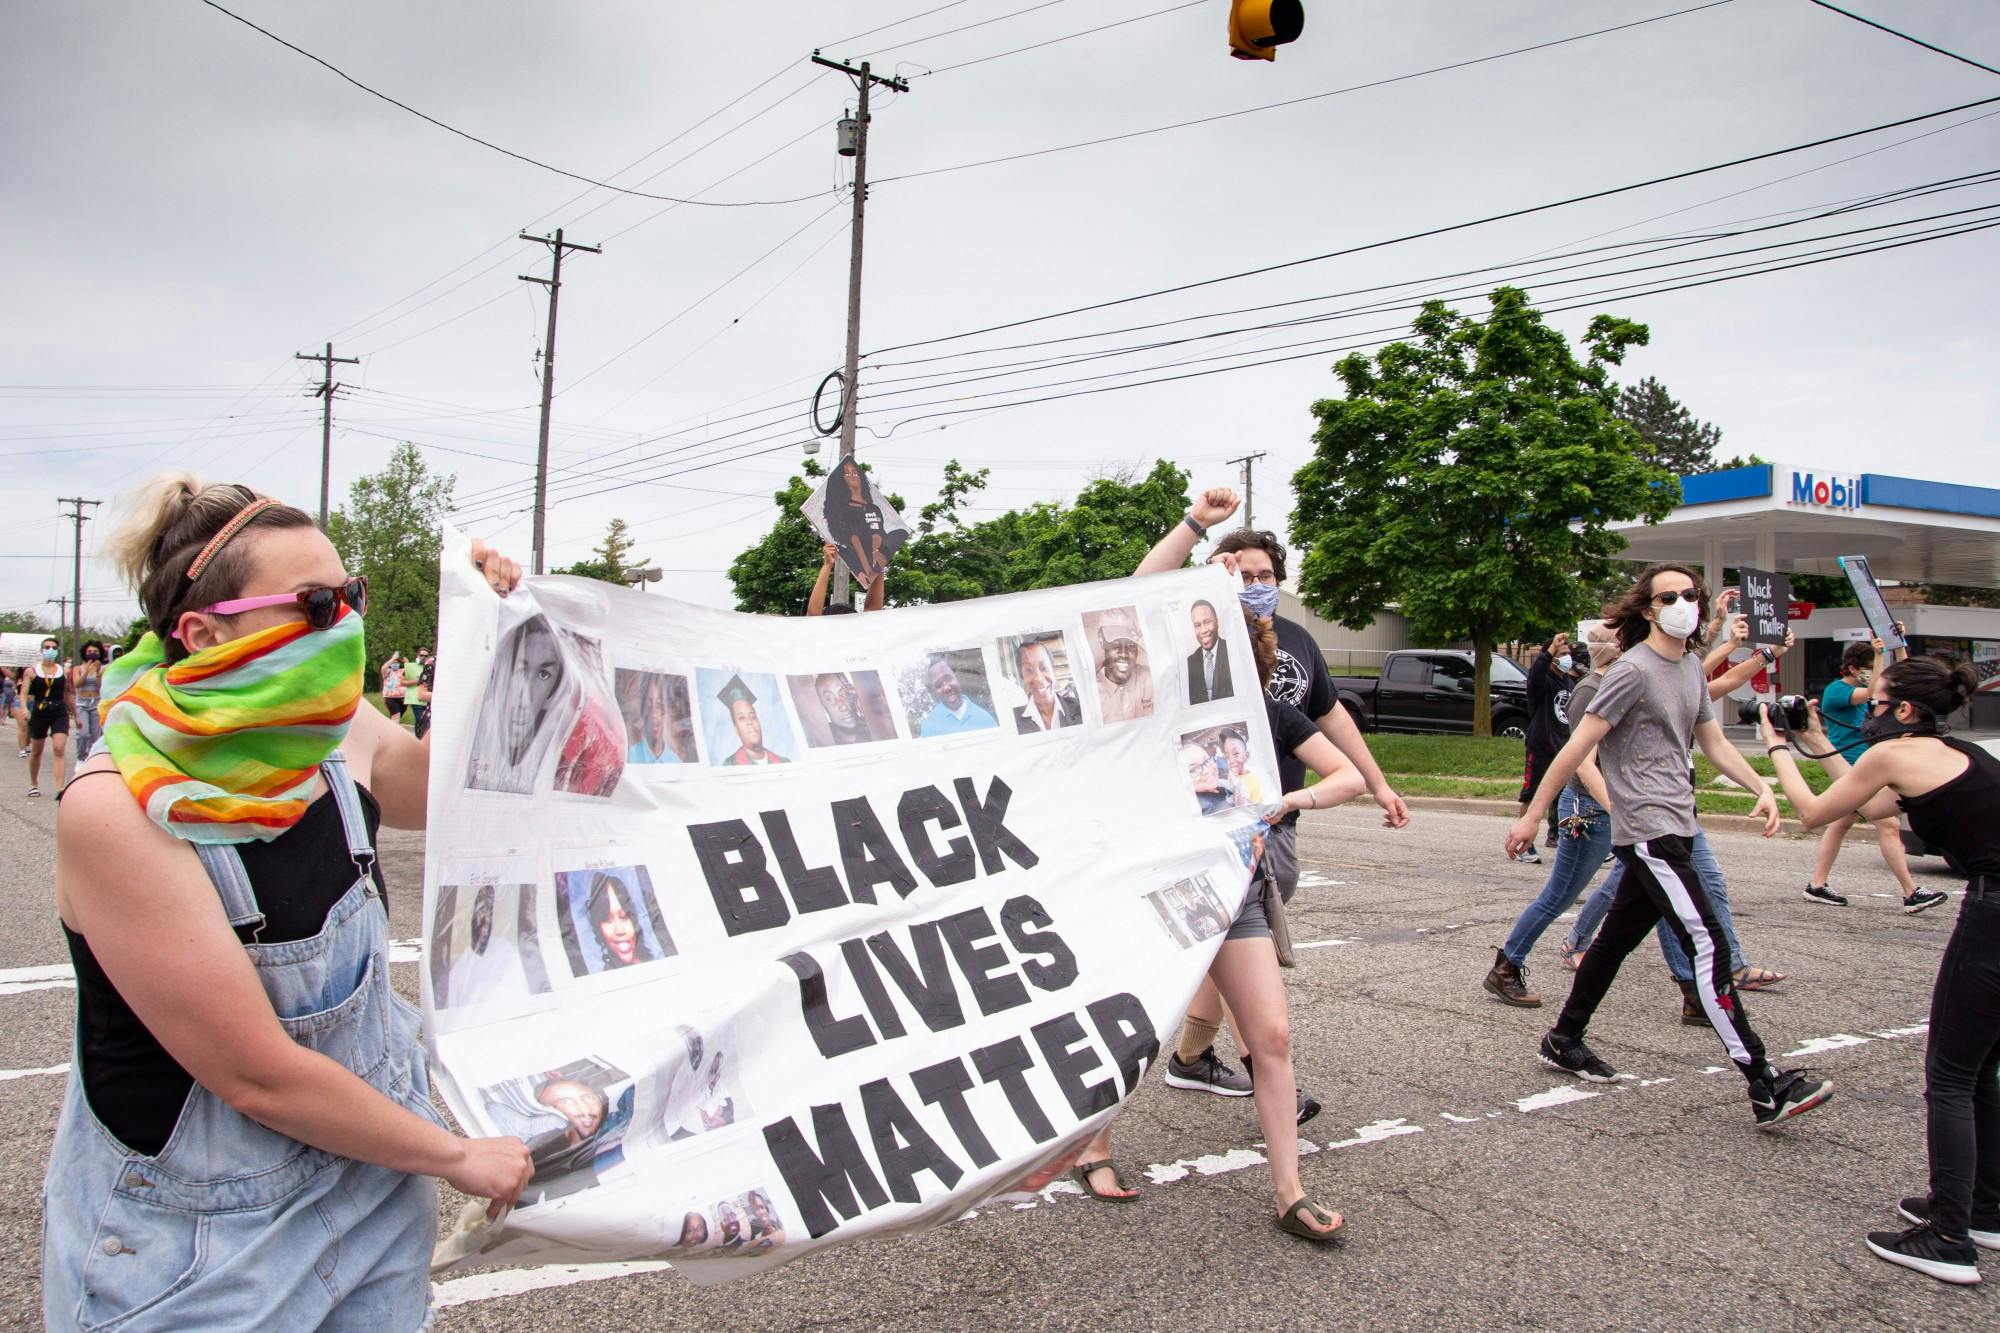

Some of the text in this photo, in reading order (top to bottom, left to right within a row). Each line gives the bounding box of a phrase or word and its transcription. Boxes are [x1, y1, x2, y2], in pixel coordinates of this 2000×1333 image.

[1793, 472, 1860, 509] Mobil
[1747, 575, 1772, 599] black
[1753, 600, 1775, 617] lives
[1760, 617, 1785, 636] matter
[687, 775, 1039, 937] BLACK
[777, 895, 1079, 1059] LIVES
[762, 993, 1160, 1239] MATTER
